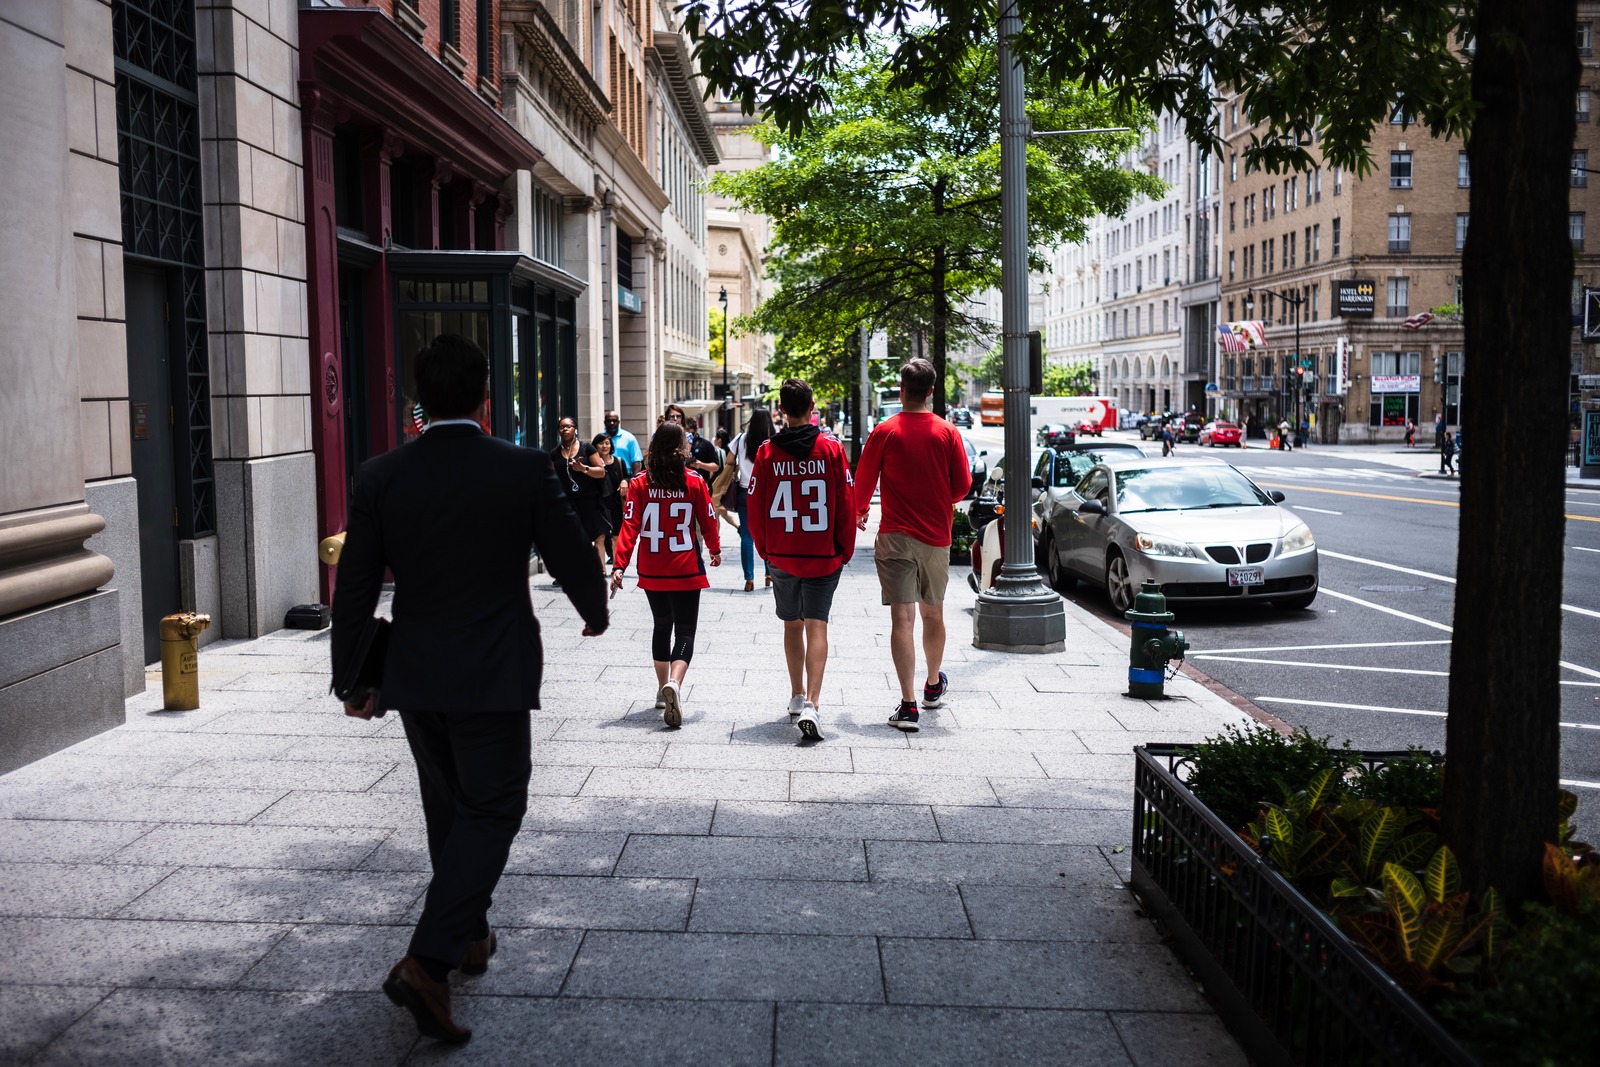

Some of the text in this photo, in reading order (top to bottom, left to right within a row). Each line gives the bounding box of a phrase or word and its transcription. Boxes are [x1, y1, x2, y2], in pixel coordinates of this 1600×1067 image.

[773, 460, 826, 476] WILSON
[648, 488, 685, 499] WILSON
[769, 479, 828, 533] 43
[640, 502, 693, 553] 43
